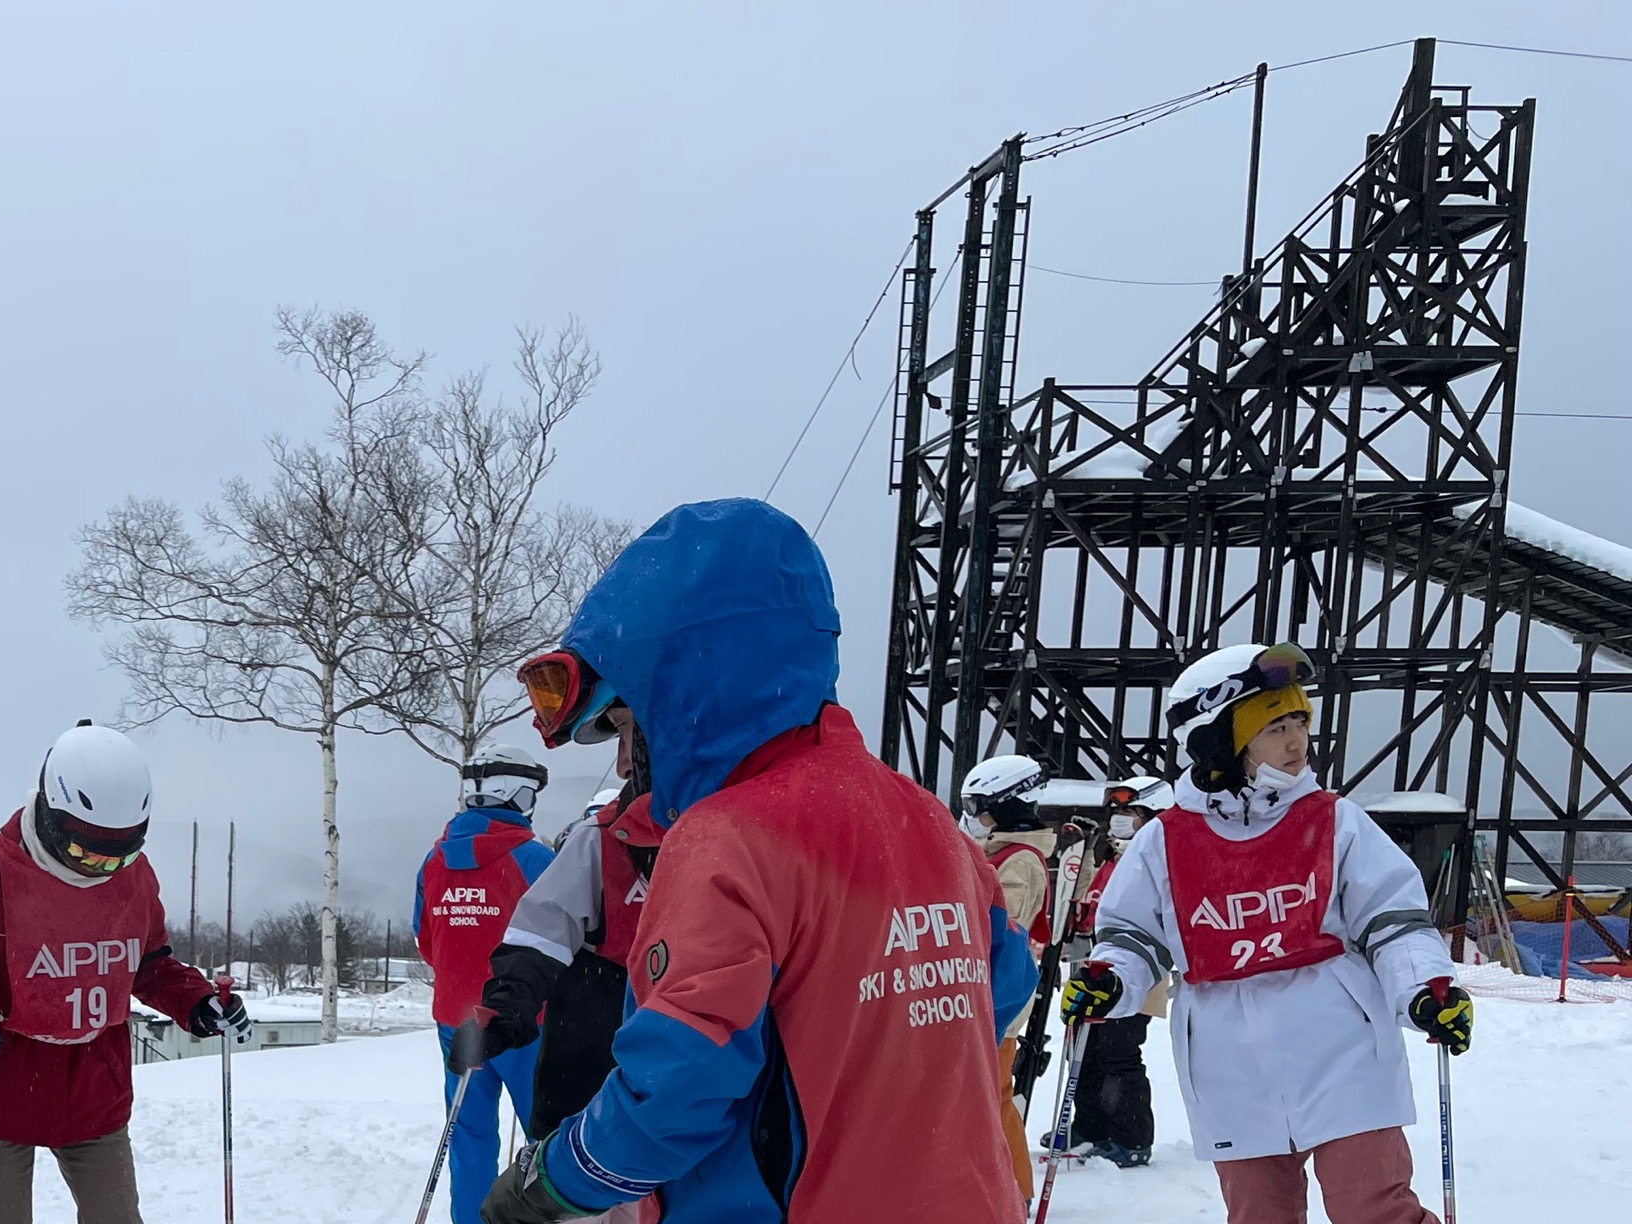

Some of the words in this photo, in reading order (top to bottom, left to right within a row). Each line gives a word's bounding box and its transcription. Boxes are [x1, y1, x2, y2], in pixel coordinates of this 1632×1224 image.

[441, 887, 486, 903] APPI
[450, 905, 500, 916] SNOWBOARD
[1190, 871, 1317, 931] APPI
[449, 916, 480, 926] SCHOOL
[884, 902, 971, 957] APPI
[25, 938, 142, 979] APPI
[1230, 931, 1286, 970] 23
[859, 971, 885, 1003] SKI
[893, 968, 906, 995] &
[65, 985, 108, 1030] 19
[909, 994, 974, 1027] SCHOOL
